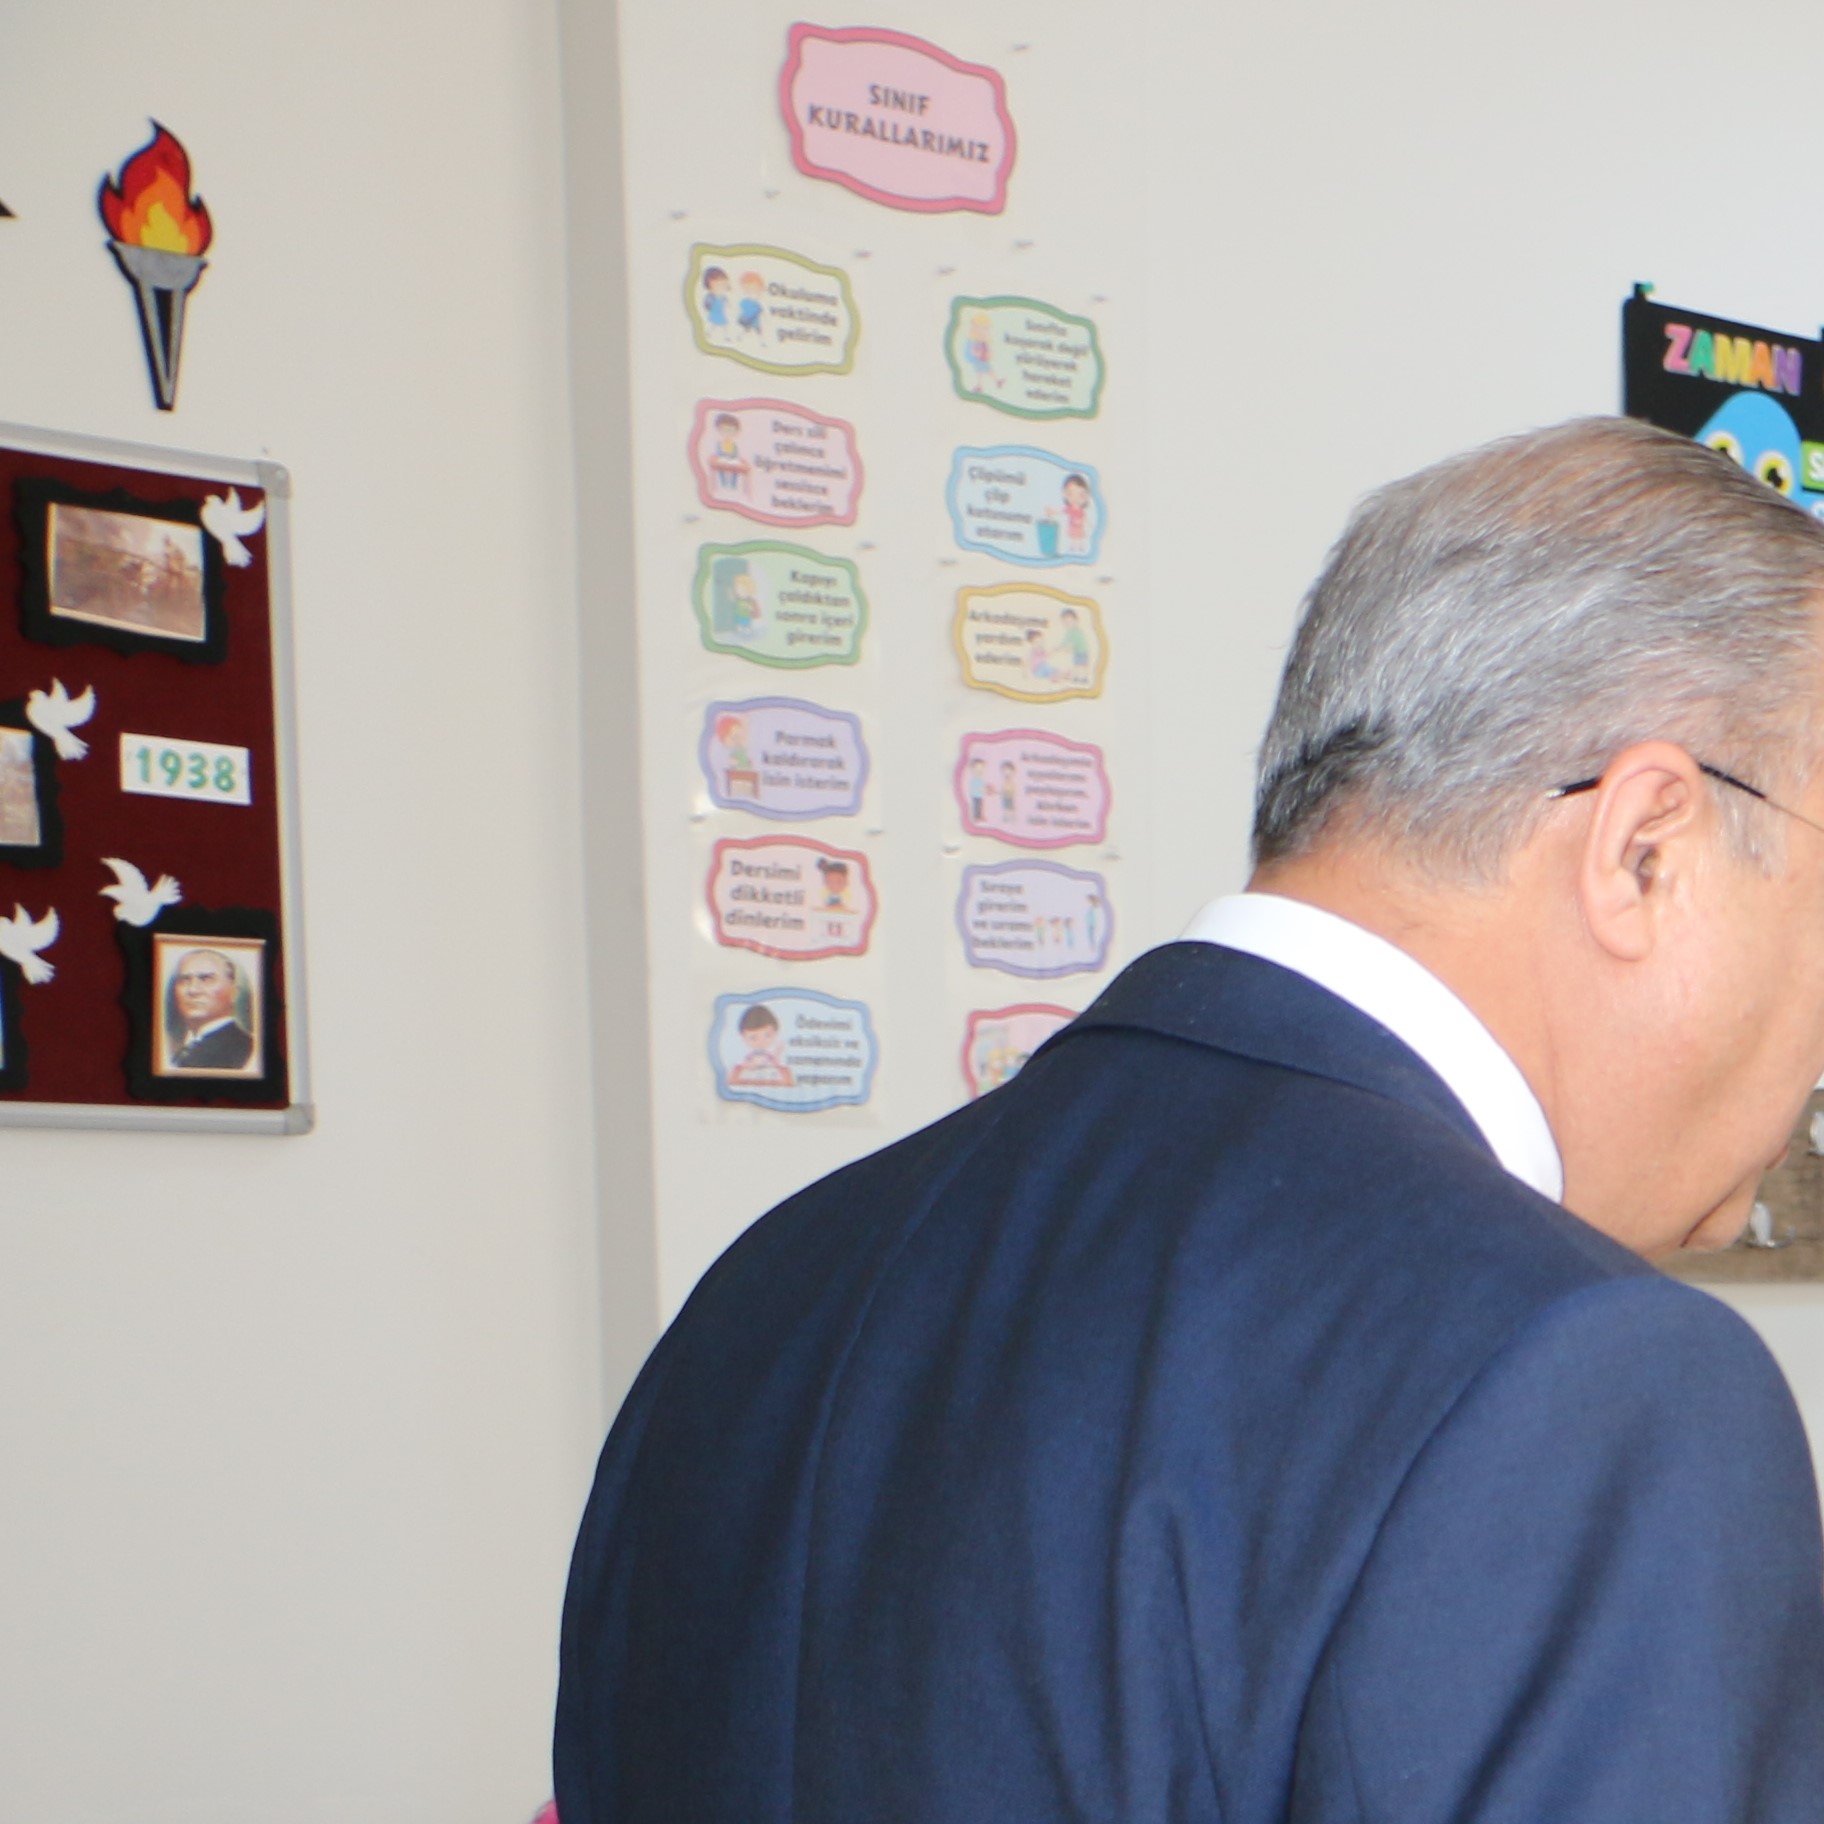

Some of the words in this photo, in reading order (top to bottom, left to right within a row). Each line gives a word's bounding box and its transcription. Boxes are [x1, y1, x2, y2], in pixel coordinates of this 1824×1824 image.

[868, 83, 930, 117] SINIF
[806, 103, 991, 165] KURALLARIMIZ
[770, 305, 838, 327] vaktinde
[776, 327, 833, 346] gelirim
[1662, 322, 1803, 397] ZAMAN
[771, 420, 802, 437] Ders
[775, 730, 837, 749] Parmak
[135, 746, 236, 793] 1938
[762, 752, 845, 770] kaldırarak
[794, 774, 850, 791] isterim
[730, 860, 802, 881] Dersimi
[725, 908, 805, 931] dinlerim
